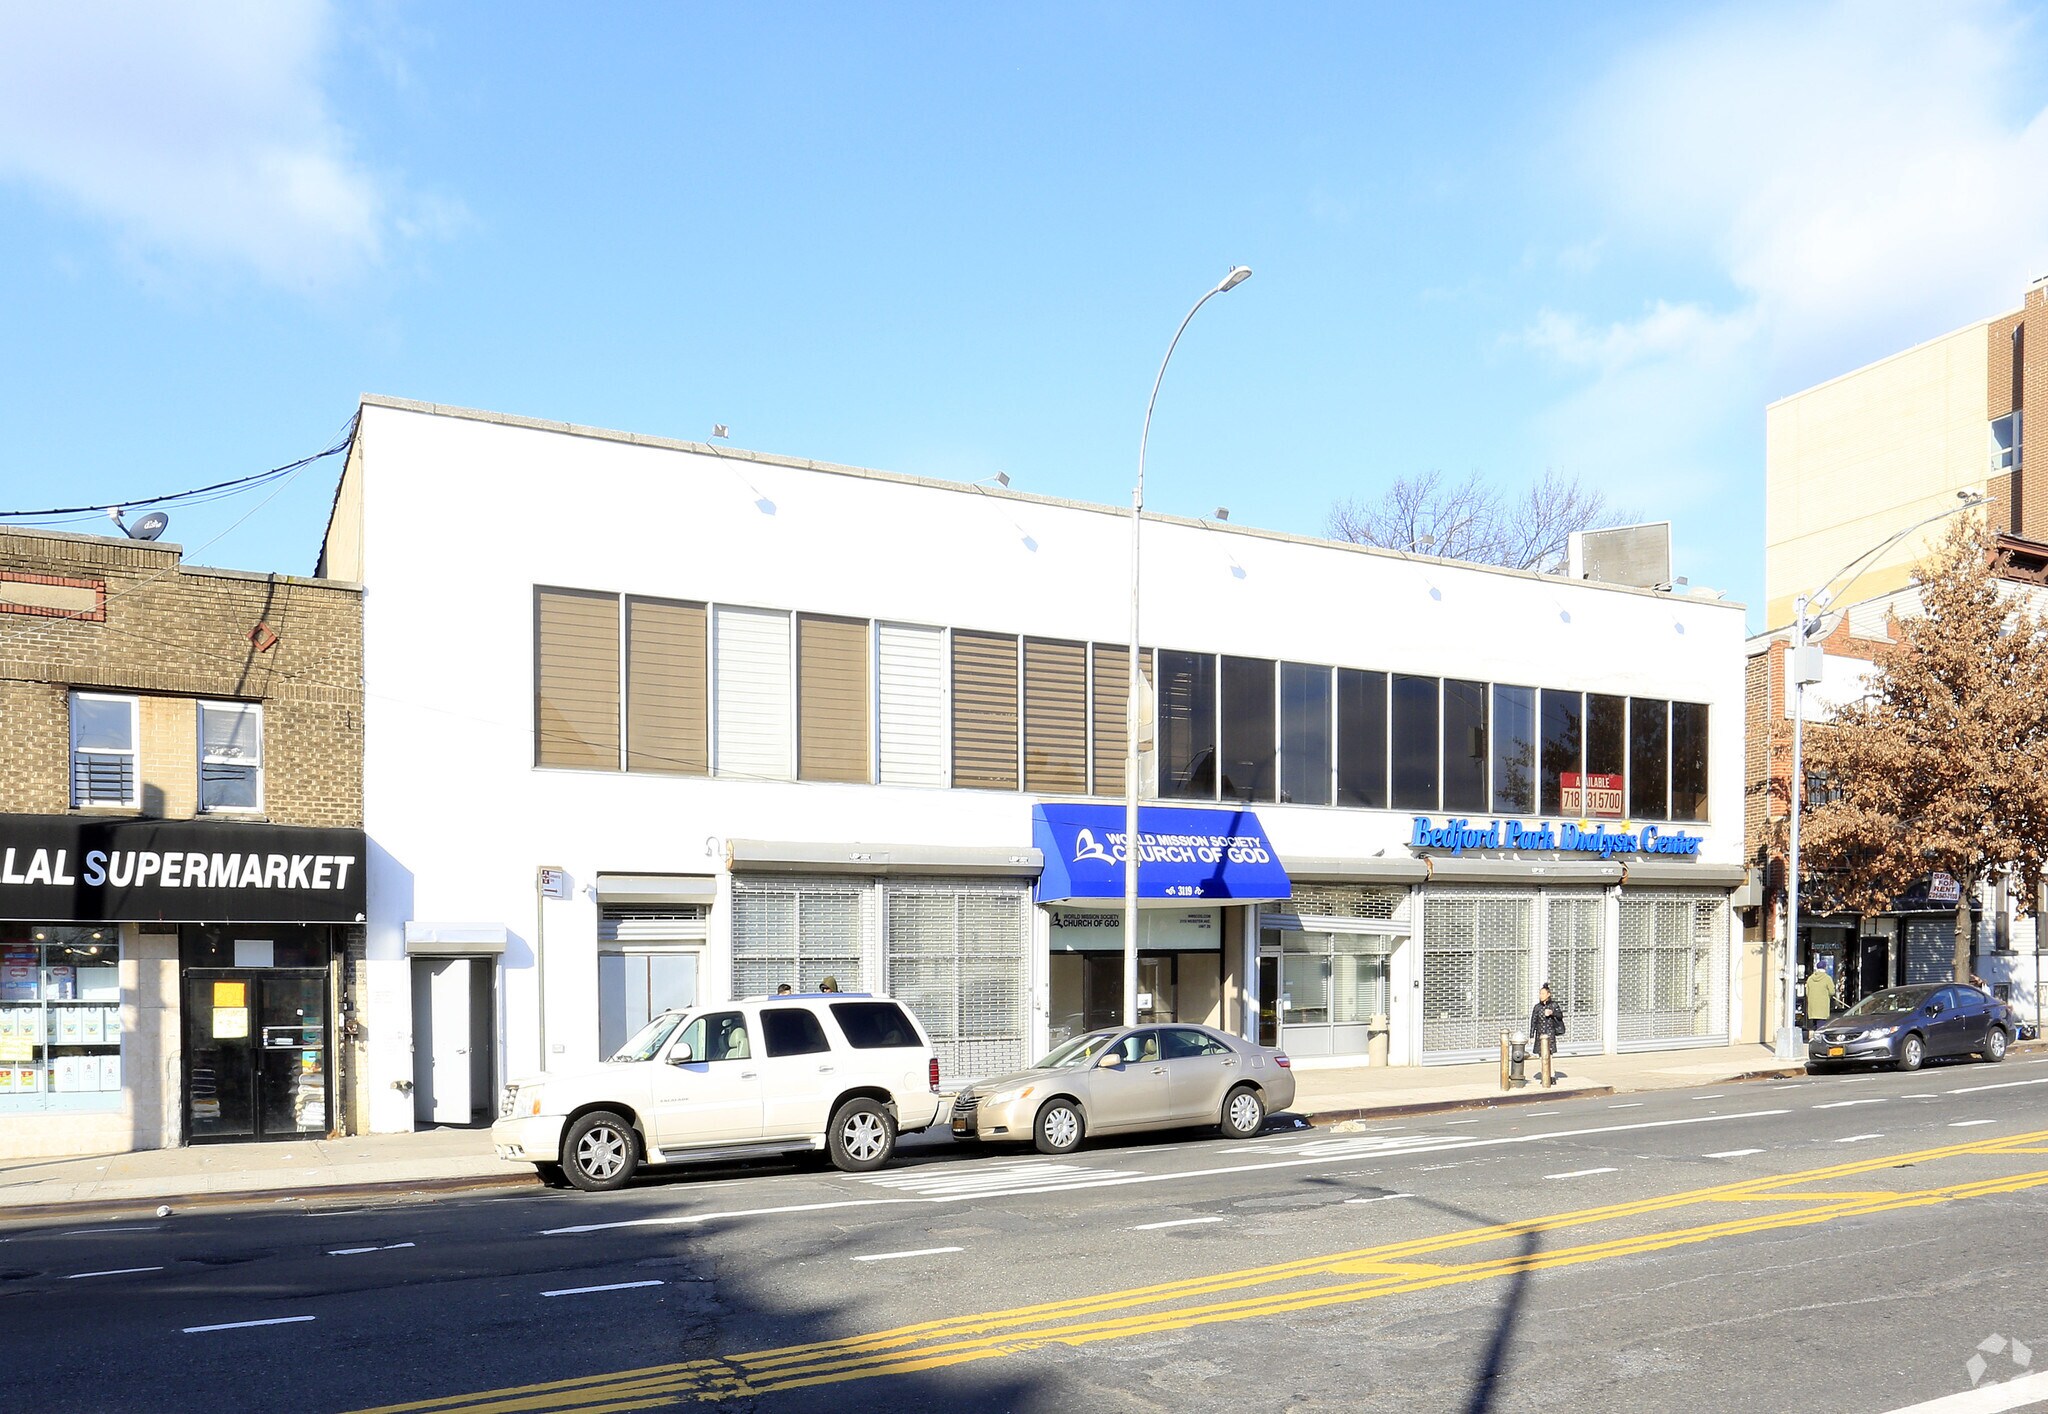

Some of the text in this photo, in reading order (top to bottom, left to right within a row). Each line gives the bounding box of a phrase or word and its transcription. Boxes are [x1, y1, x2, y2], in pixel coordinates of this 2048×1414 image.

[1576, 776, 1610, 788] AAILABLE
[1106, 833, 1261, 848] WOLD MISSION SOCIETY
[1412, 817, 1703, 858] Bedford Park Dialysis Center
[1197, 847, 1223, 863] OF
[1227, 848, 1270, 864] GOD
[83, 850, 356, 890] SUPERMARKET
[1178, 885, 1193, 896] 3119
[1063, 919, 1120, 927] CHURCH OF GOD
